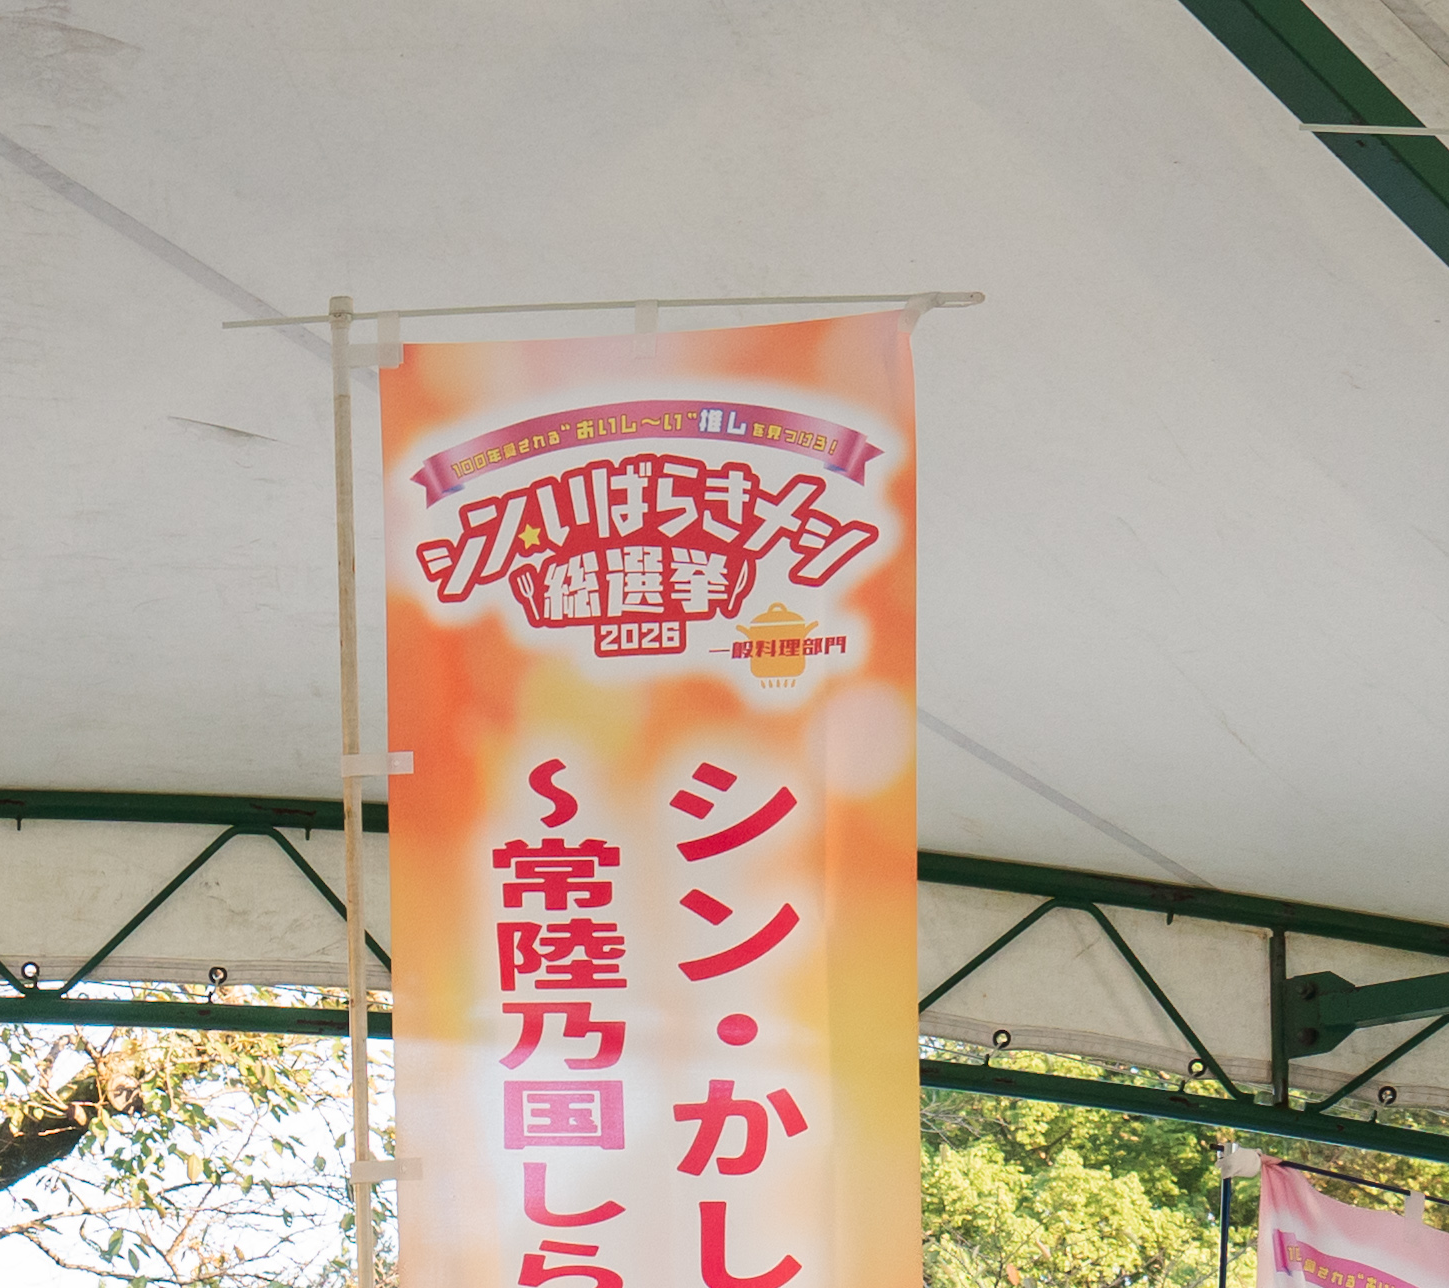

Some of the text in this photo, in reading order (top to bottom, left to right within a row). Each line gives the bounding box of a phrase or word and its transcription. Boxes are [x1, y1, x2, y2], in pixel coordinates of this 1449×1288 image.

[423, 462, 871, 595] シンいばらきメシ
[544, 546, 729, 620] 総選挙
[600, 623, 680, 651] 2026
